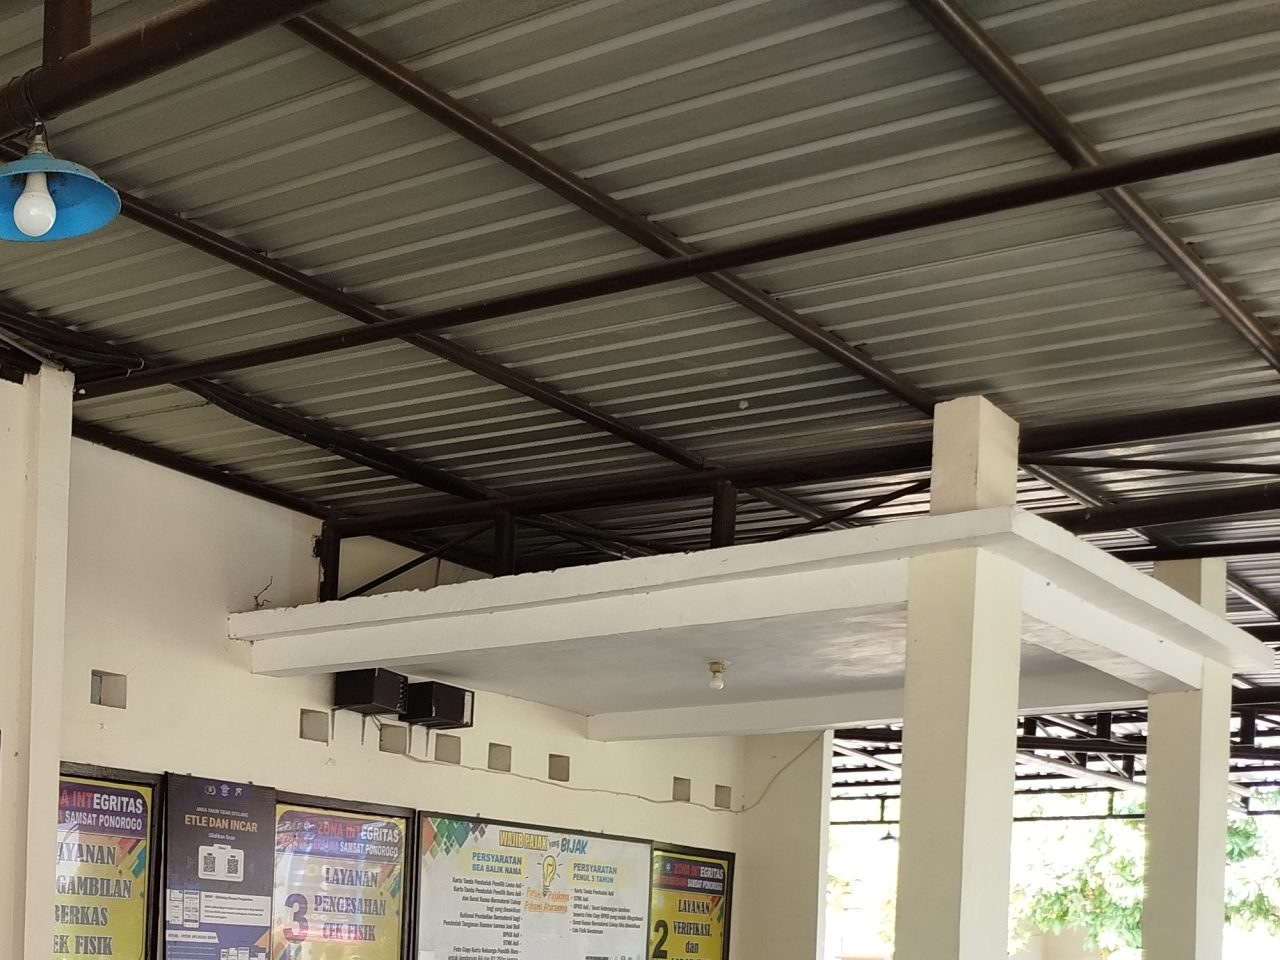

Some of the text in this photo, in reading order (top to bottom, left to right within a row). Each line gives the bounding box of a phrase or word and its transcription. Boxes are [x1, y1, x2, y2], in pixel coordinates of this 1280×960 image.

[73, 791, 143, 814] INTEGRITAS
[65, 811, 98, 826] SAMSAT
[99, 814, 142, 830] PONOROGO
[185, 814, 258, 832] ETLE DAN INCAR
[346, 824, 399, 843] INTEGRITAS
[340, 841, 364, 854] SAMSAT
[365, 844, 398, 857] PONOROGO
[561, 838, 588, 854] BIJAK
[472, 852, 522, 865] PERSYARATAN
[325, 867, 378, 887] LAYANAN
[573, 863, 617, 874] PERSYARATAN
[678, 899, 710, 914] LAYANAN
[283, 893, 385, 943] 3 PENGESAHAN
[348, 924, 375, 941] FISIK
[652, 920, 668, 959] 2
[75, 936, 112, 955] FISIK
[685, 941, 698, 953] dan
